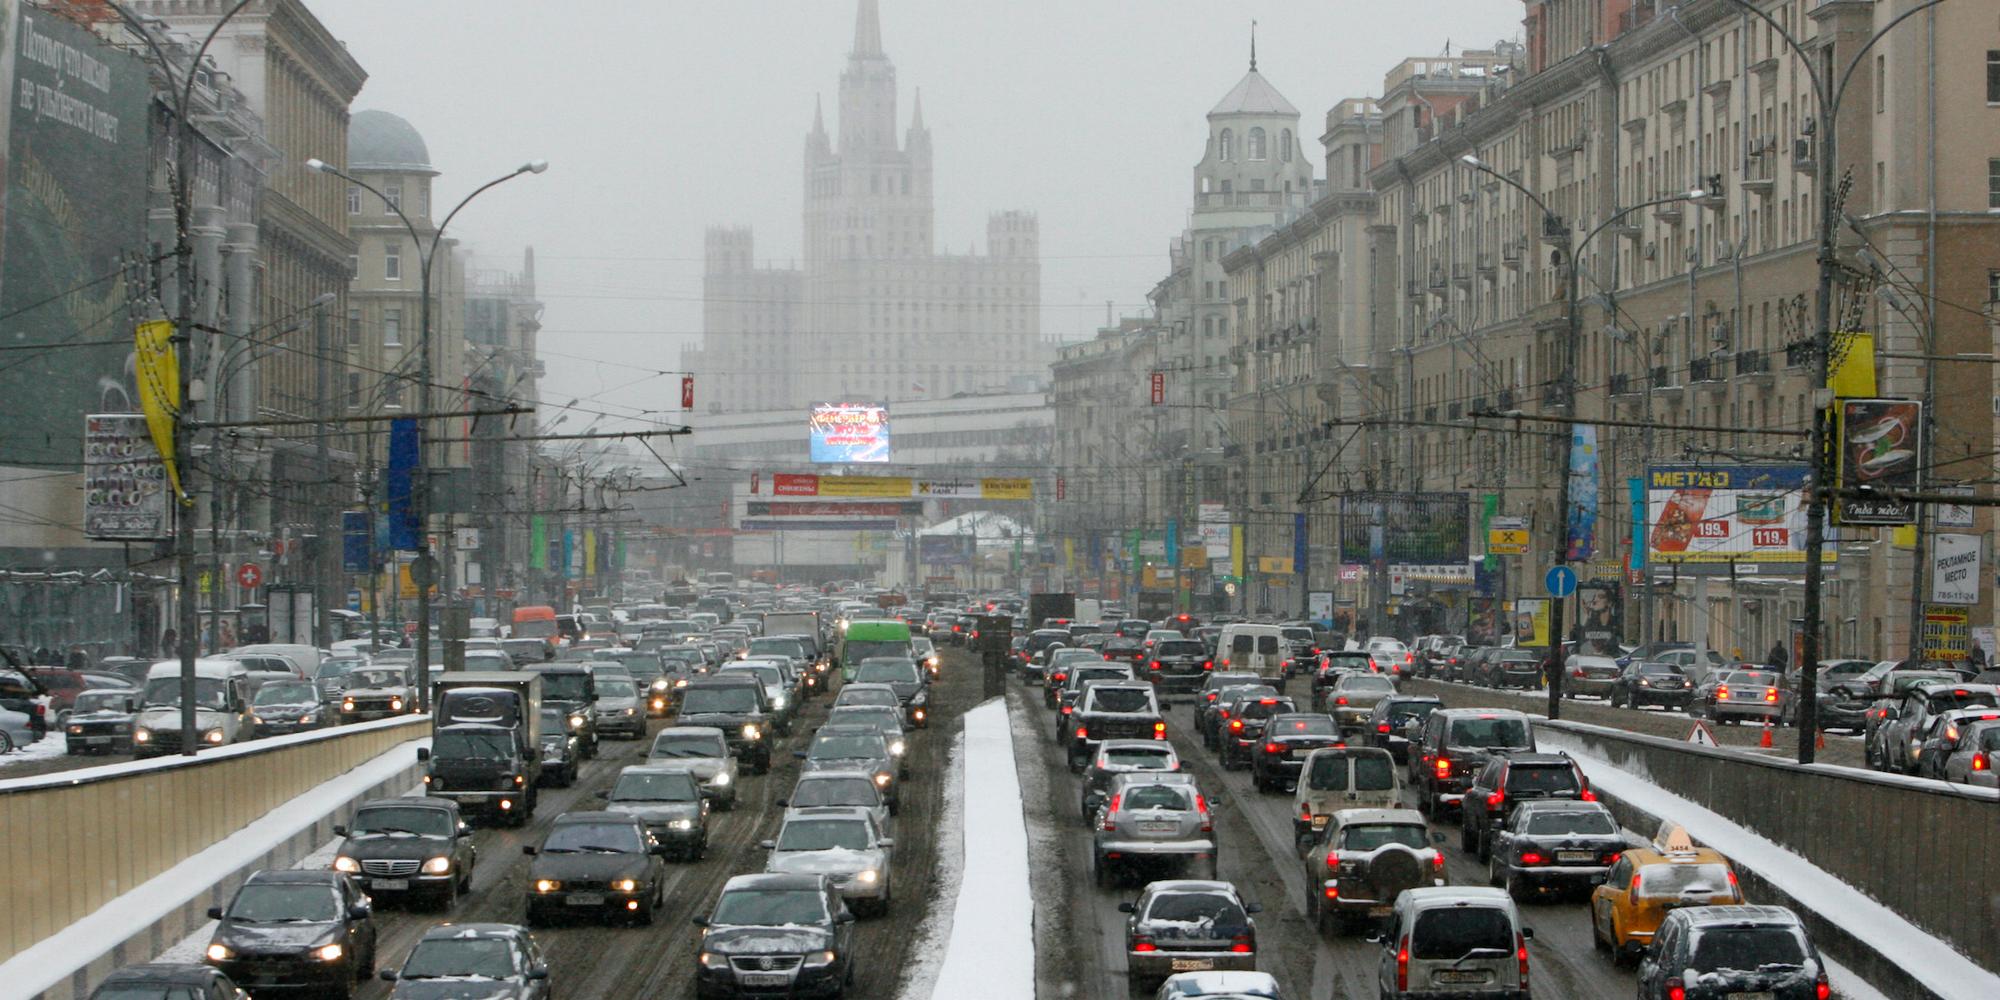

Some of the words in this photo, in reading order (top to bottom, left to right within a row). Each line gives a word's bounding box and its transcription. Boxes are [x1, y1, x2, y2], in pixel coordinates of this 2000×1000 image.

[22, 16, 64, 80] Потому
[64, 45, 82, 79] что
[20, 77, 35, 111] не
[1653, 472, 1729, 487] METRO
[1937, 551, 1976, 570] РЕКЛАМНОЕ
[1945, 569, 1967, 583] МЕСТО
[1925, 650, 1937, 659] 24
[1940, 651, 1965, 660] часа
